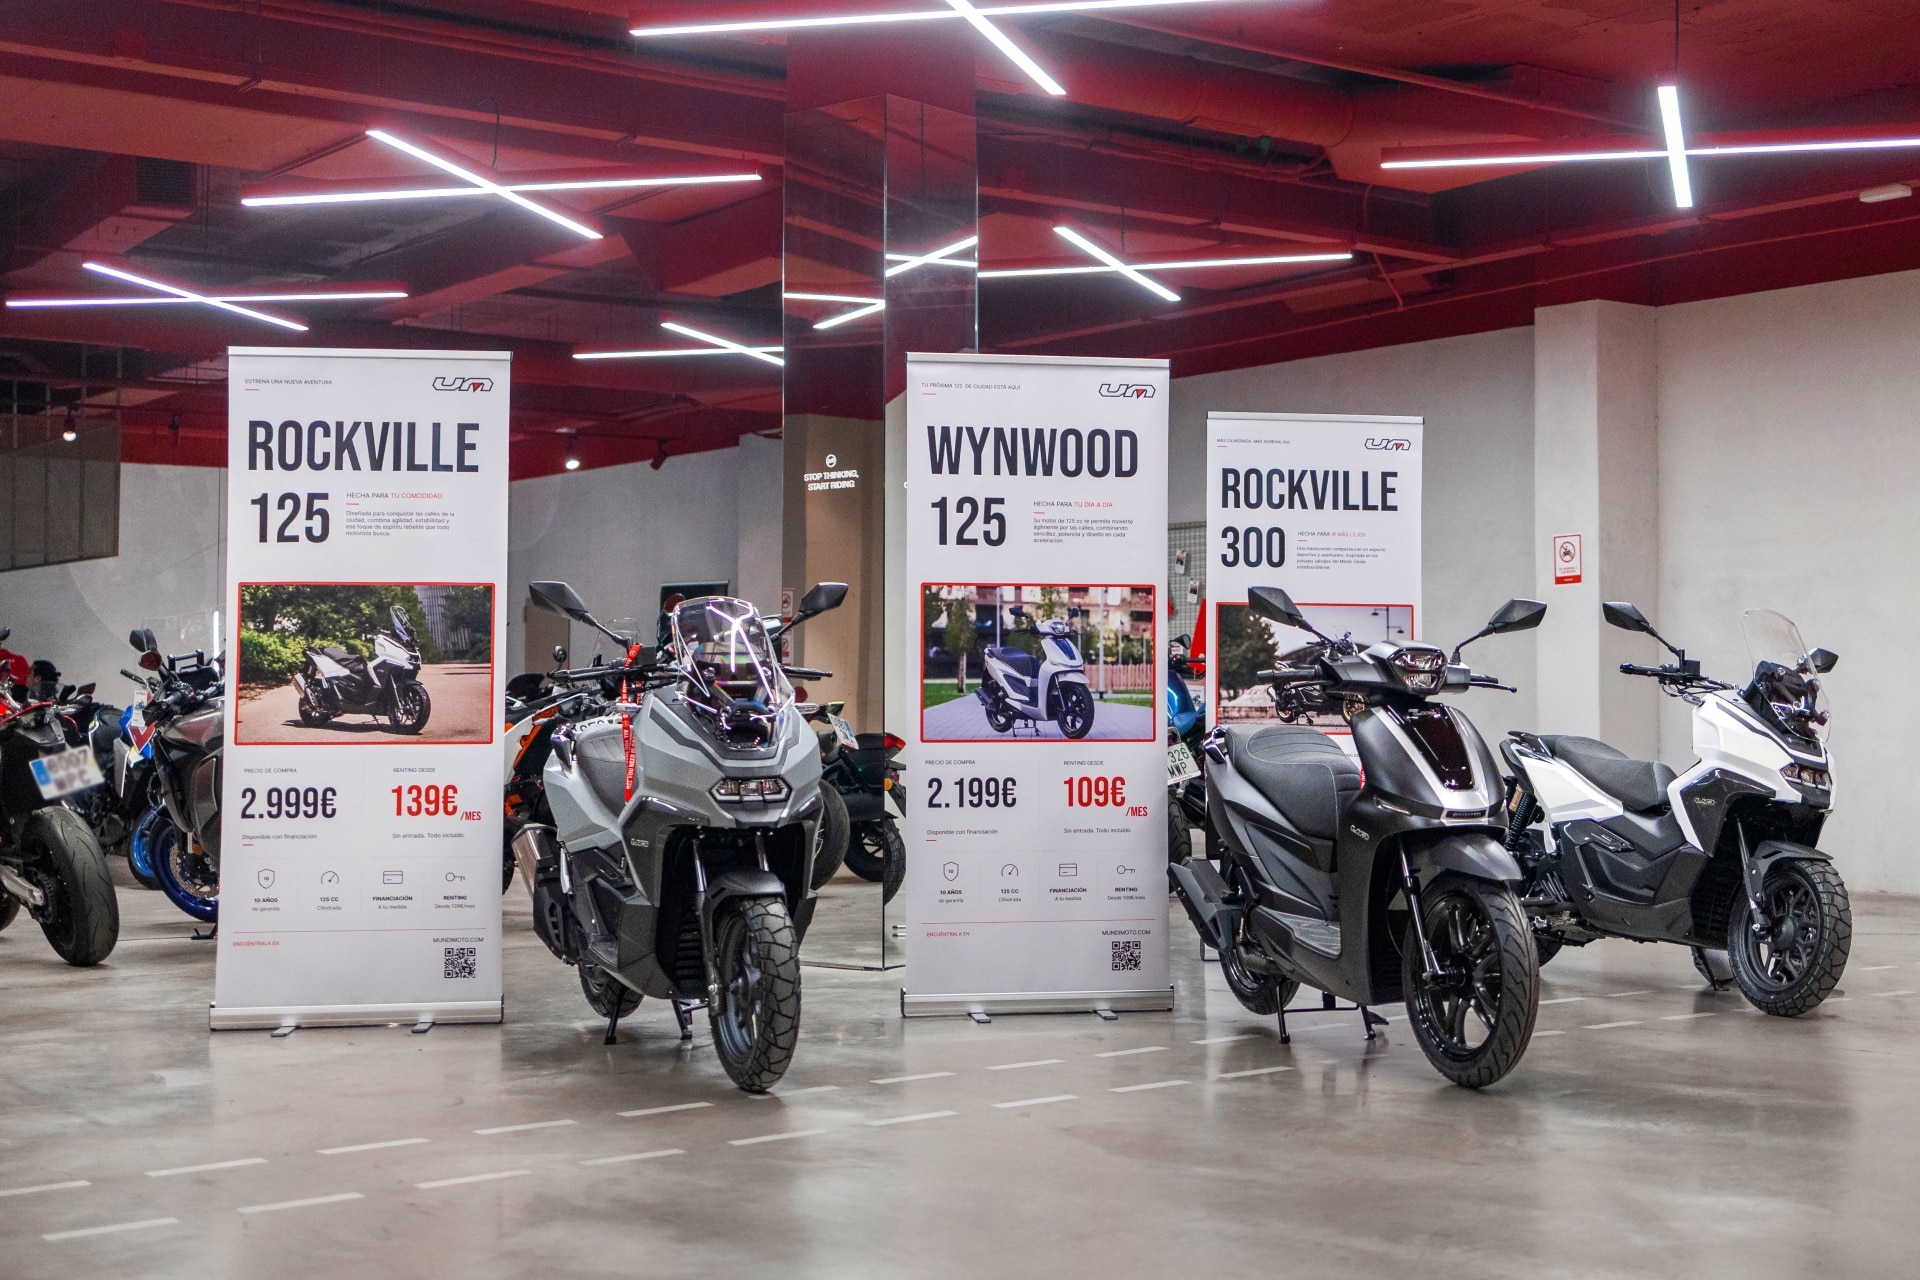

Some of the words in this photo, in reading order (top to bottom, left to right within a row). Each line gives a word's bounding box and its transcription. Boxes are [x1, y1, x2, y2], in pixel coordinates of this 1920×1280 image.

[248, 420, 480, 472] ROCKVILLE
[927, 425, 1138, 478] WYNWOOD
[803, 473, 822, 481] STOP
[823, 470, 859, 480] THINKING,
[807, 482, 830, 491] START
[830, 480, 855, 489] RIDING
[1221, 467, 1398, 511] ROCKVILLE
[250, 492, 330, 543] 125
[930, 496, 1007, 546] 125
[1221, 526, 1286, 568] 300
[240, 787, 337, 820] 2.999€
[391, 784, 458, 817] 139€
[460, 811, 481, 821] /MES
[927, 777, 1017, 809] 2.199€
[1063, 776, 1126, 808] 109€
[1125, 806, 1148, 817] /MES
